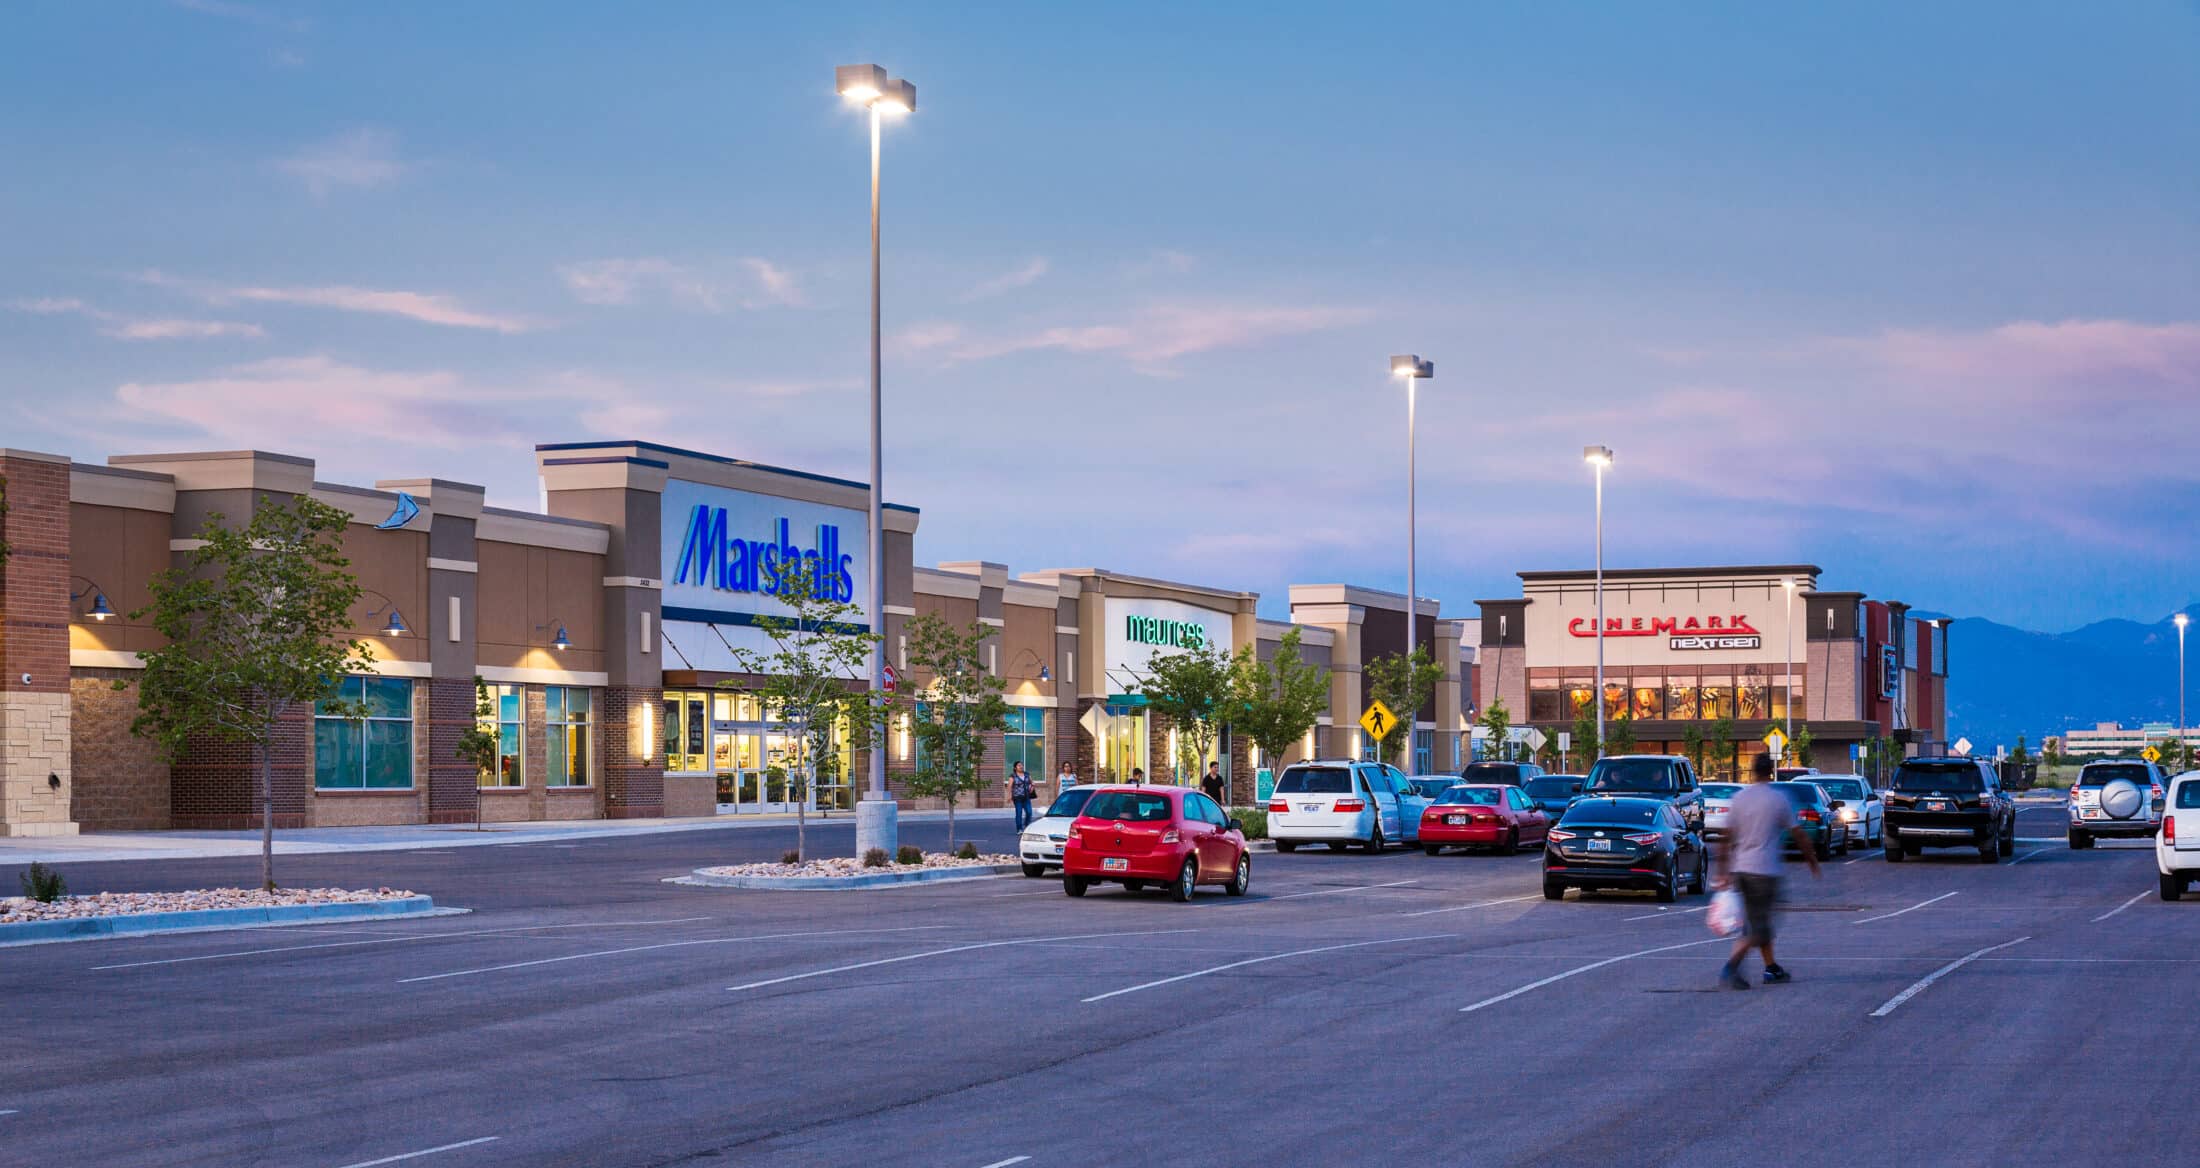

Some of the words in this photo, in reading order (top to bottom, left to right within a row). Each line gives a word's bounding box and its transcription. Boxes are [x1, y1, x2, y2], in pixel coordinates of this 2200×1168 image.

[675, 504, 853, 604] Marshalls
[1126, 613, 1205, 649] maurices
[1568, 615, 1761, 638] CINEMARK
